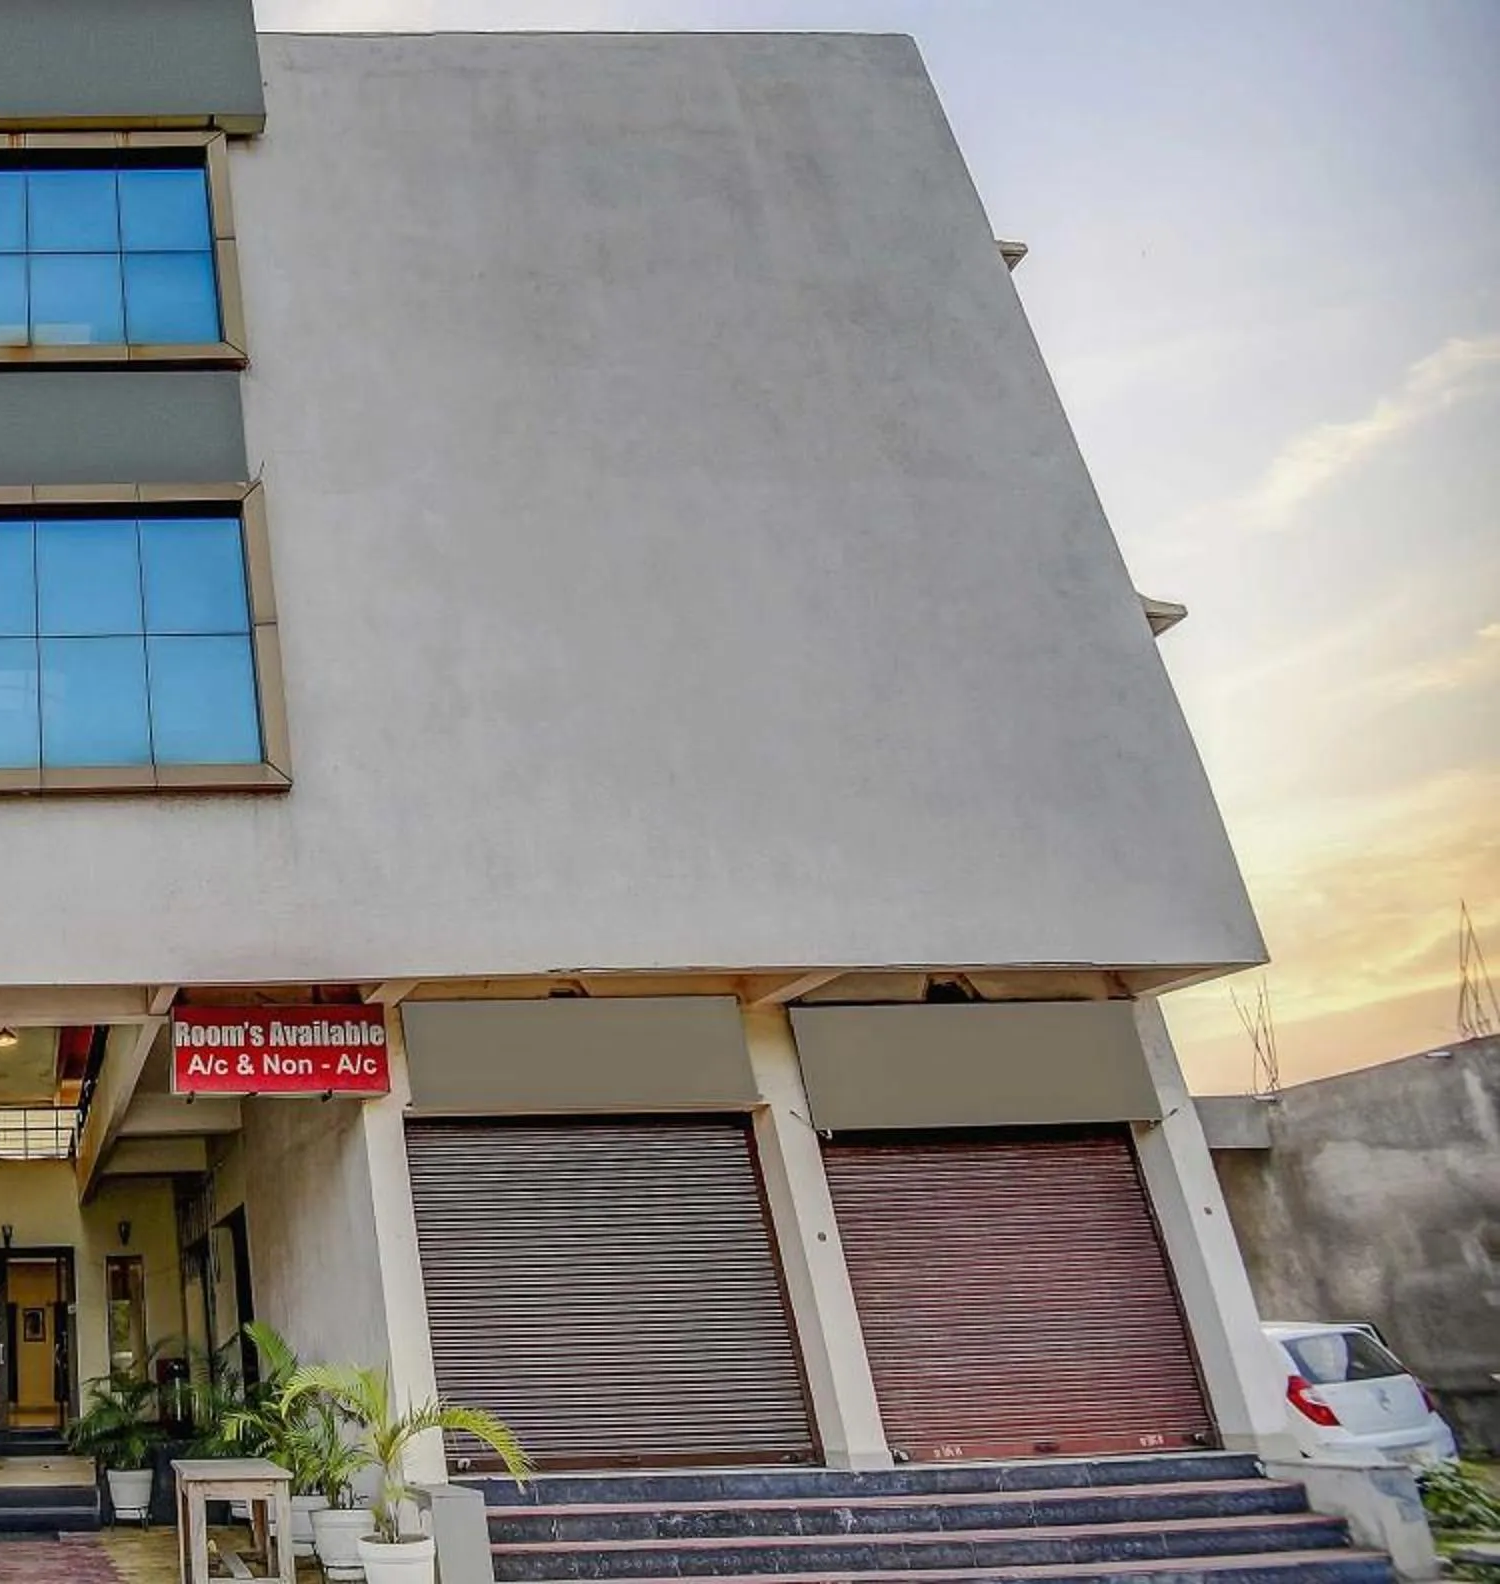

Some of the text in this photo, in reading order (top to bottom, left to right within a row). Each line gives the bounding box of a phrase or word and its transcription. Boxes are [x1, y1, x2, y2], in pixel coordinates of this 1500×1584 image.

[174, 1020, 385, 1047] Room's Available
[187, 1053, 229, 1075] A/c
[236, 1053, 255, 1075] &
[263, 1053, 313, 1075] Non
[336, 1053, 377, 1075] A/c
